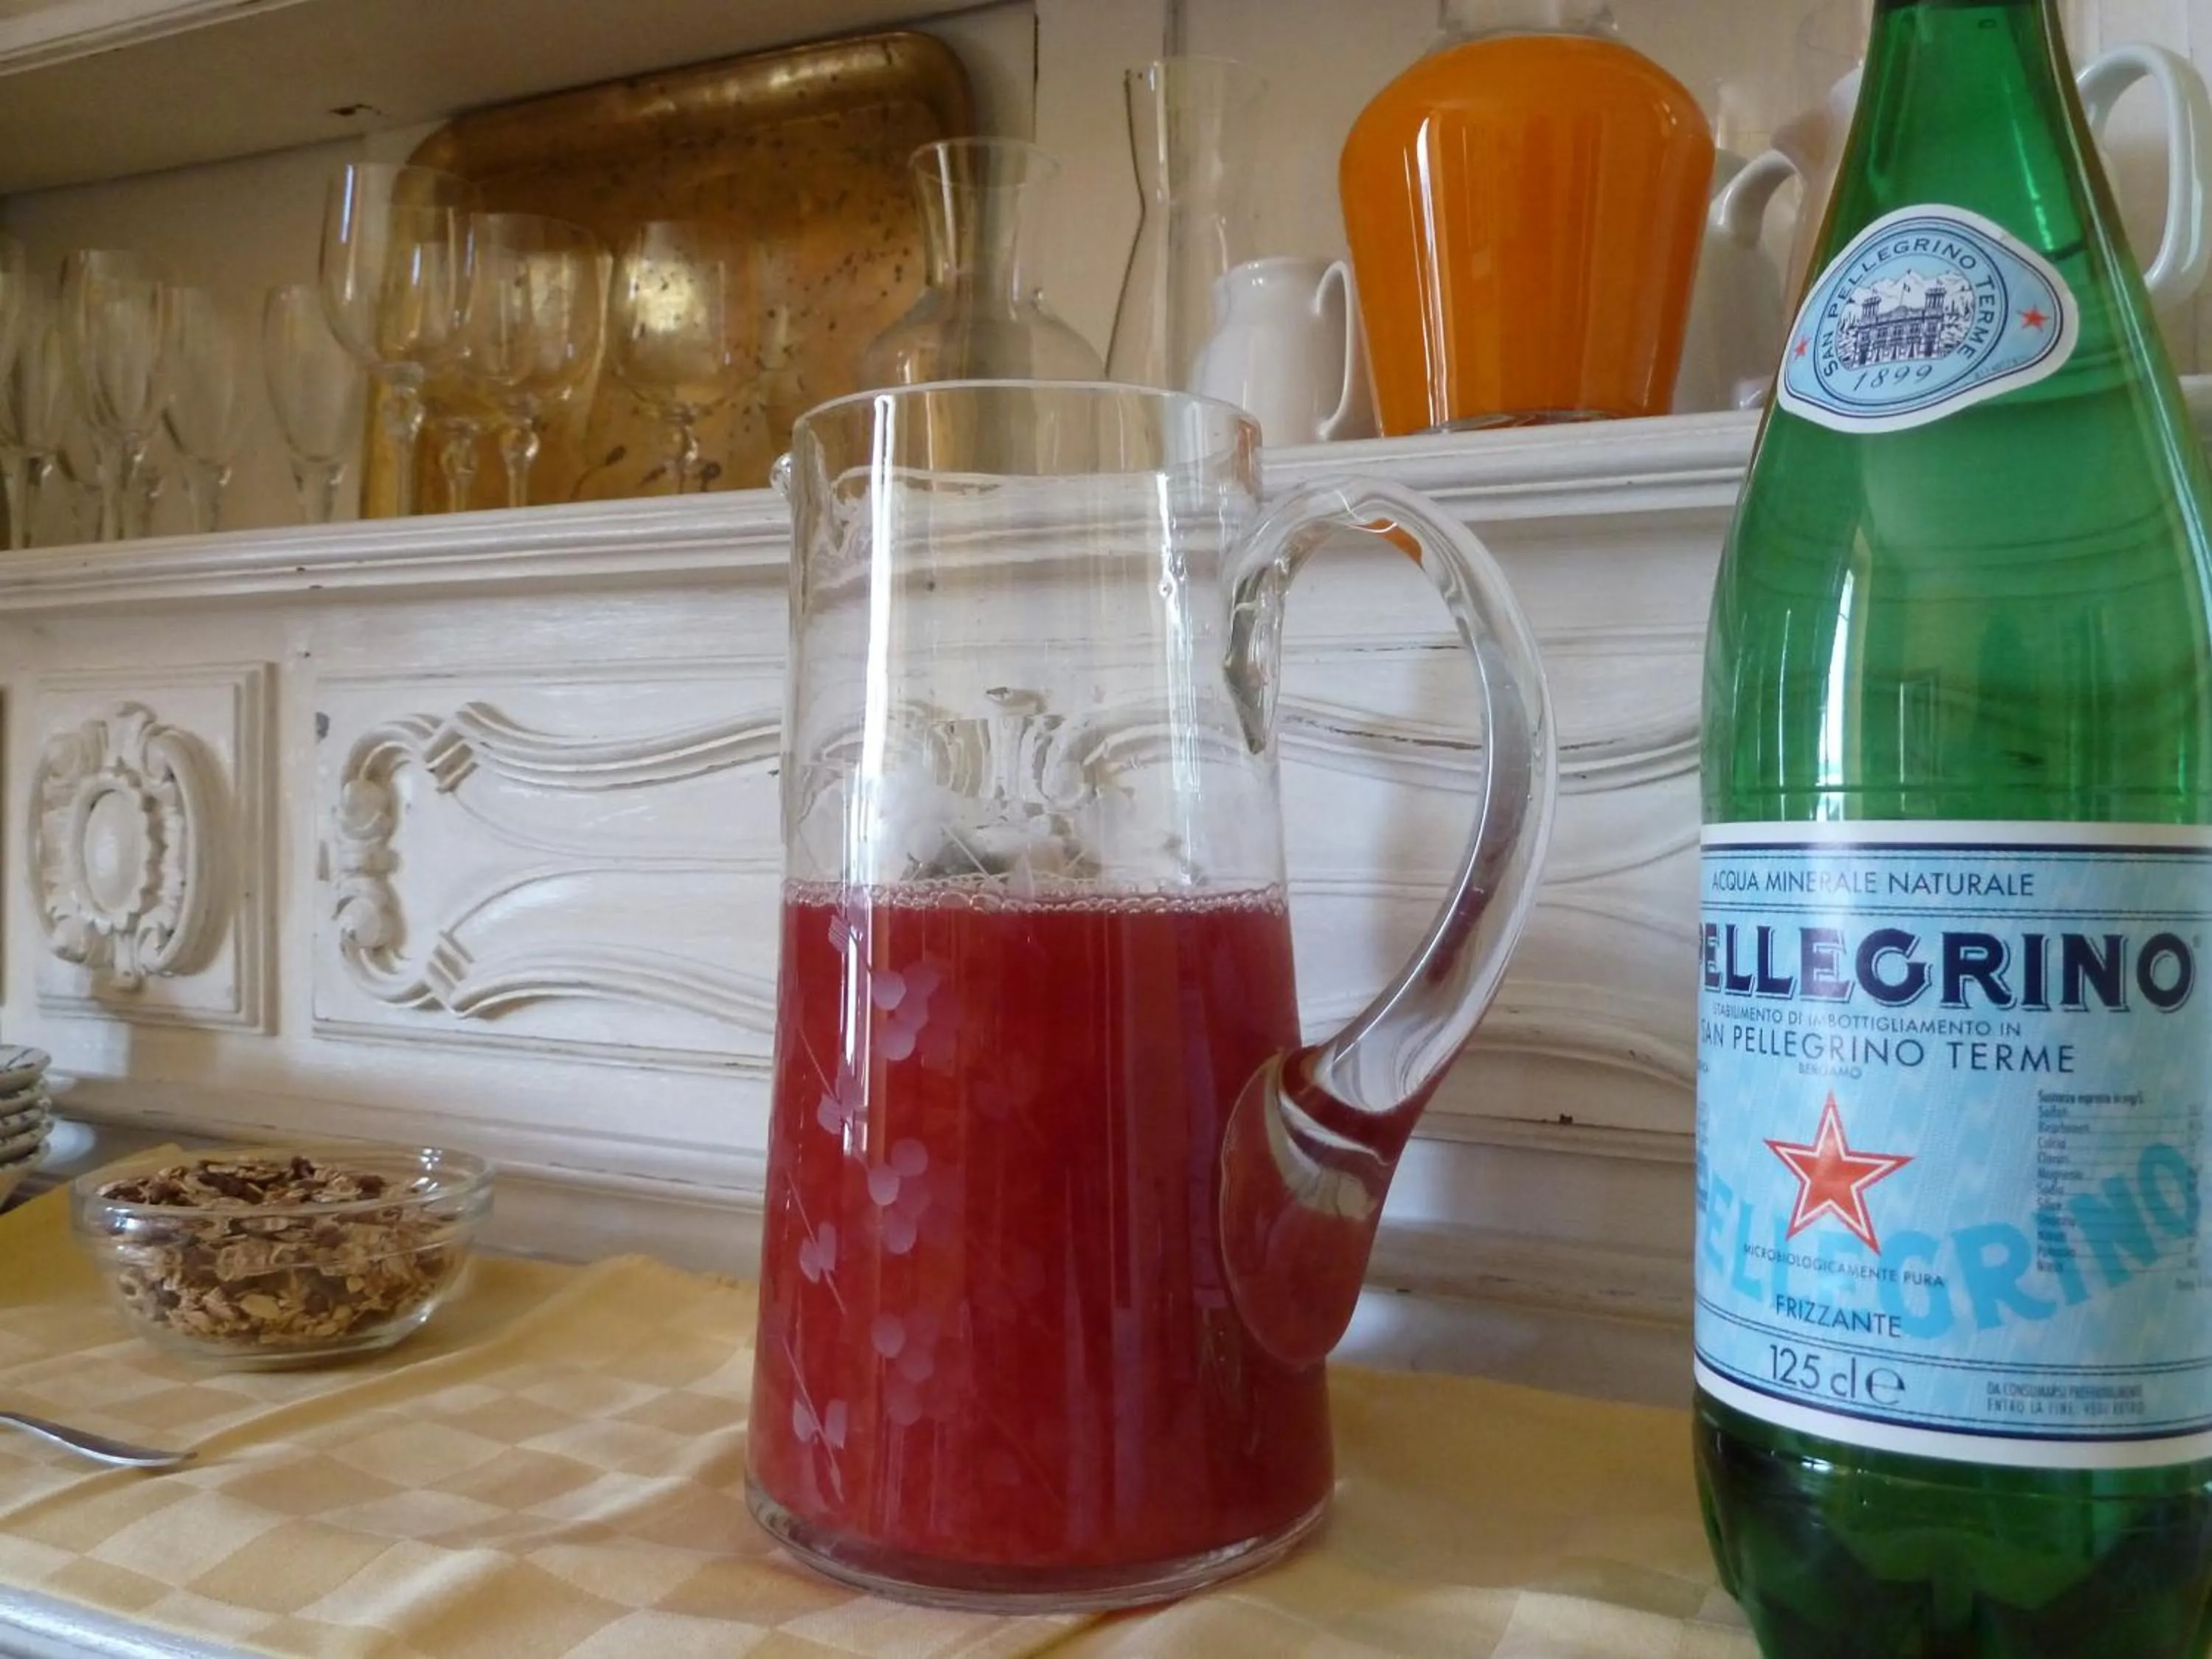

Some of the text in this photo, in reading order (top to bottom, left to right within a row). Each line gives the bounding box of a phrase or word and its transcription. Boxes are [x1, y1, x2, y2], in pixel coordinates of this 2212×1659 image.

[1823, 237, 1996, 378] SAN PELLEGRINO TERME
[1852, 365, 1933, 392] 1899
[1712, 870, 2034, 897] ACQUA MINERALE NATURALE
[2000, 1022, 2022, 1037] IN
[1733, 1026, 1925, 1068] PELLEGRINO
[1946, 1041, 2076, 1074] TERME
[1903, 1270, 1947, 1288] PURA
[1775, 1293, 1902, 1339] FRIZZANTE
[1770, 1343, 1821, 1391] 125
